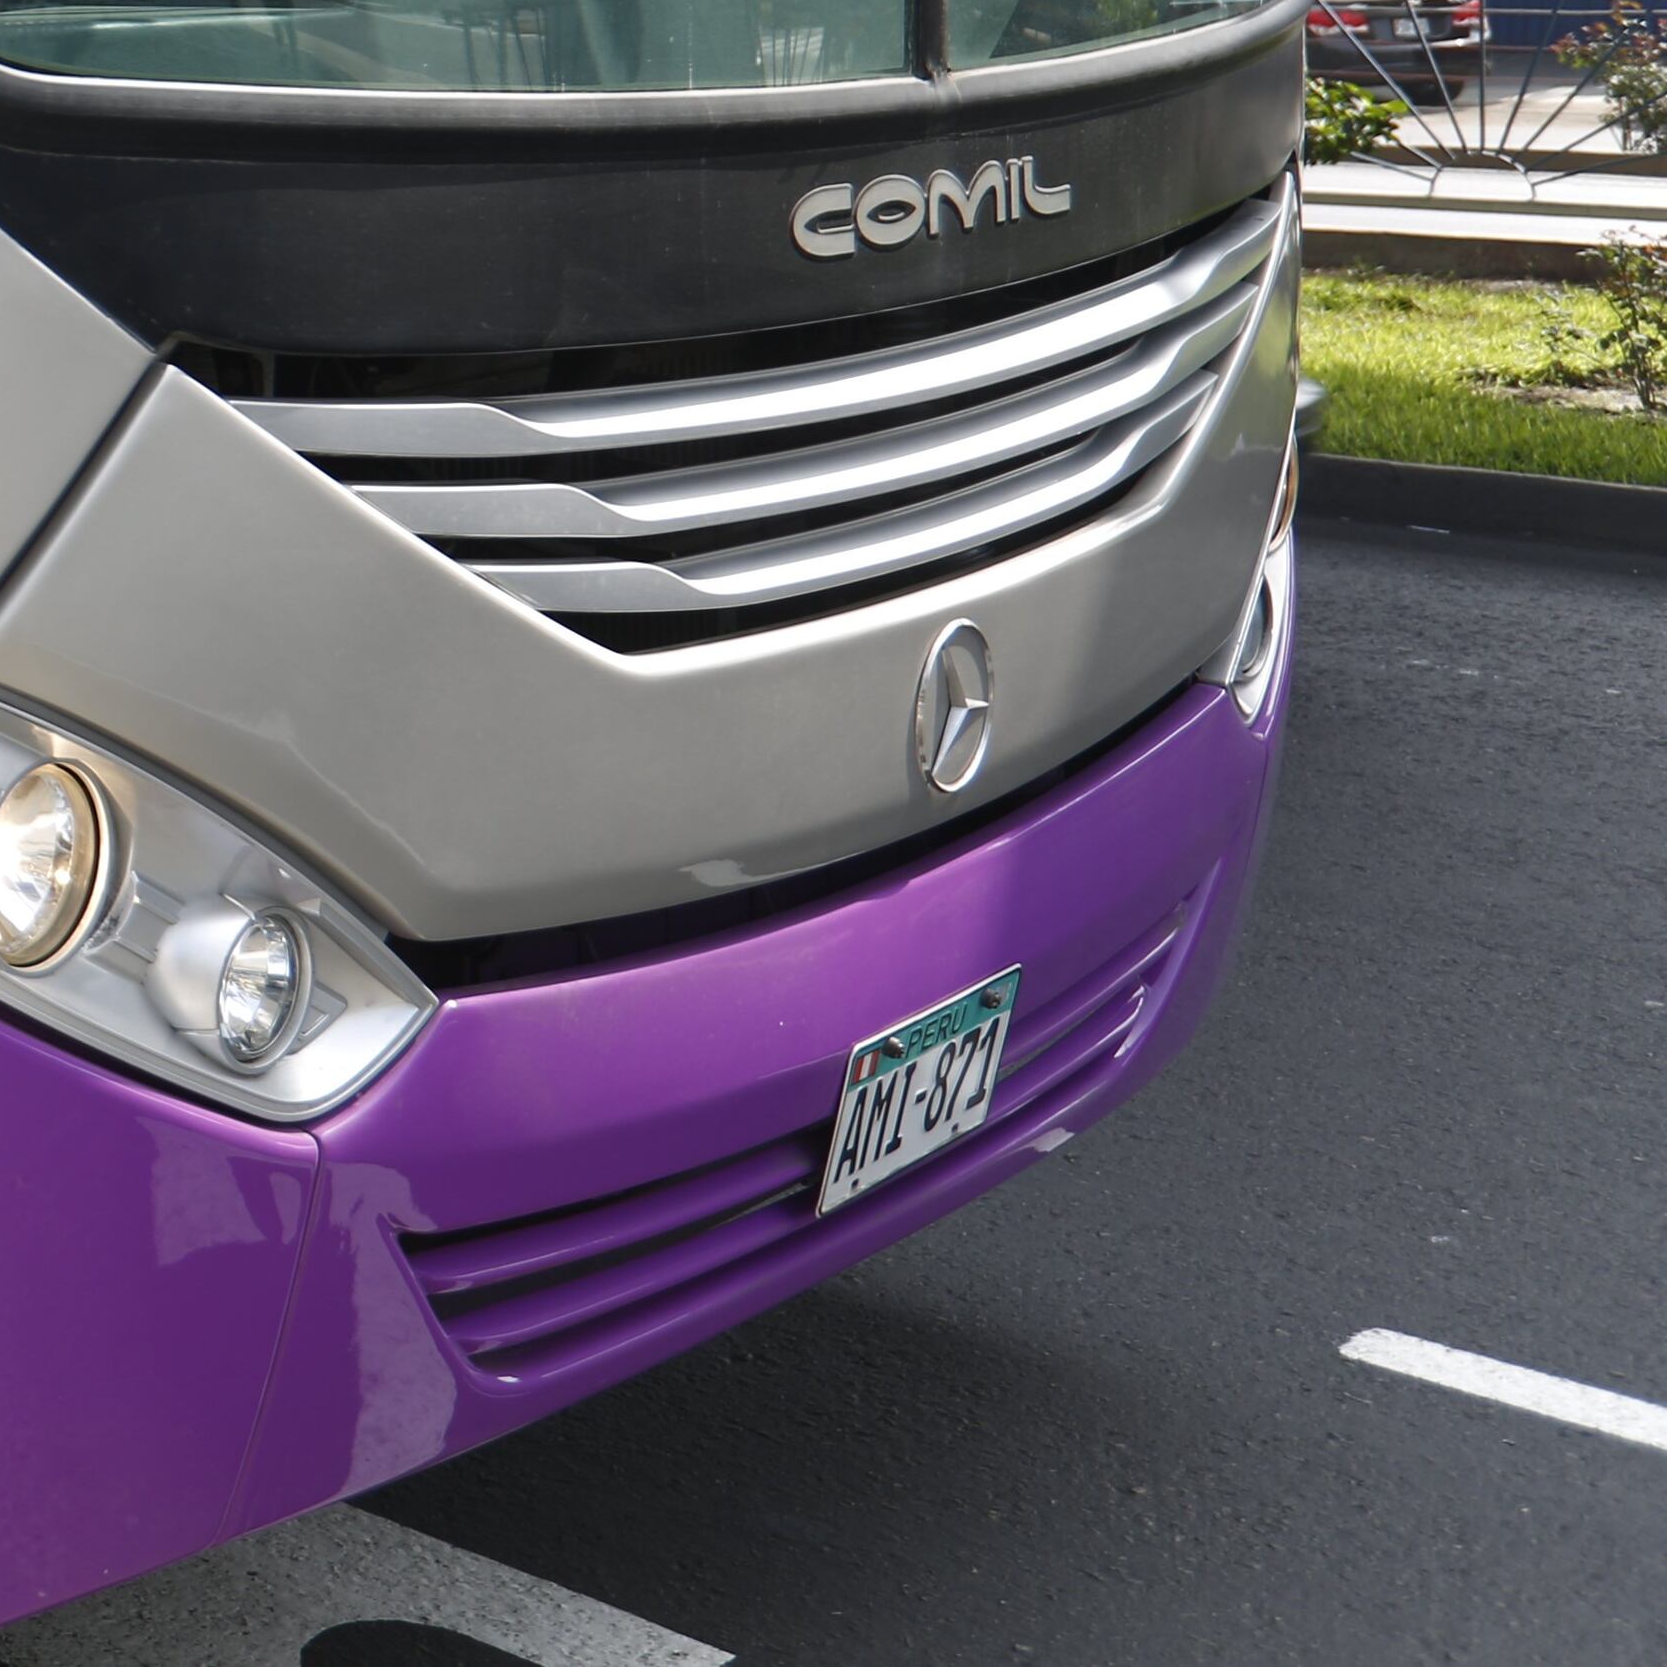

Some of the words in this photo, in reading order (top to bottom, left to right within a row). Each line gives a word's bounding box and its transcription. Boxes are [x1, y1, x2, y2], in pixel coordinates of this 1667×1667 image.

[789, 155, 1071, 259] COMIL
[904, 1001, 968, 1070] PERU
[833, 1016, 1001, 1184] AMI-871
